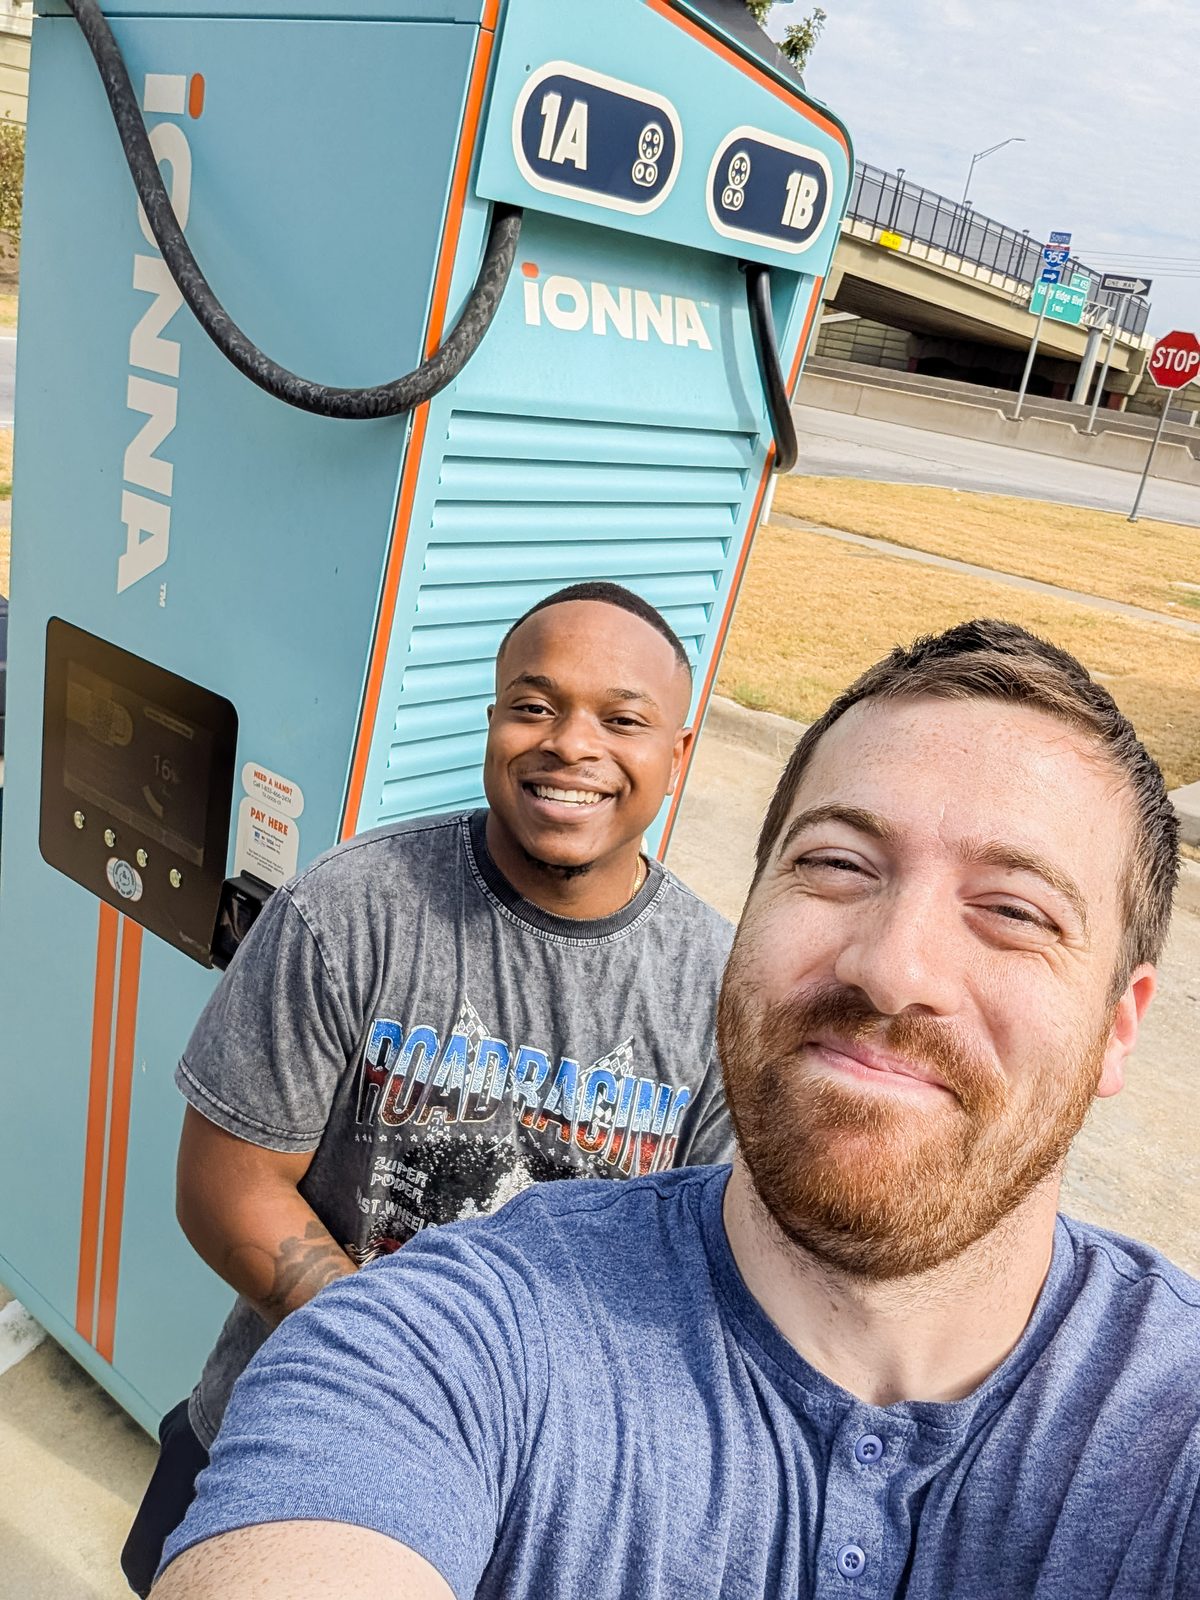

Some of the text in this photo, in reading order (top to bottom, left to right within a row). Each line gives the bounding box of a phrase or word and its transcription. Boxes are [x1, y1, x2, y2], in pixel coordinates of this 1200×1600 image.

[537, 90, 590, 172] 1A
[780, 168, 820, 230] 1B
[1045, 251, 1066, 264] 35E
[1122, 281, 1135, 289] WAY
[1152, 346, 1200, 373] STOP
[253, 770, 293, 796] NEED A HAND?
[250, 806, 266, 824] PAY
[267, 816, 289, 837] HERE
[374, 1156, 430, 1188] SUPER
[370, 1172, 425, 1205] POWER
